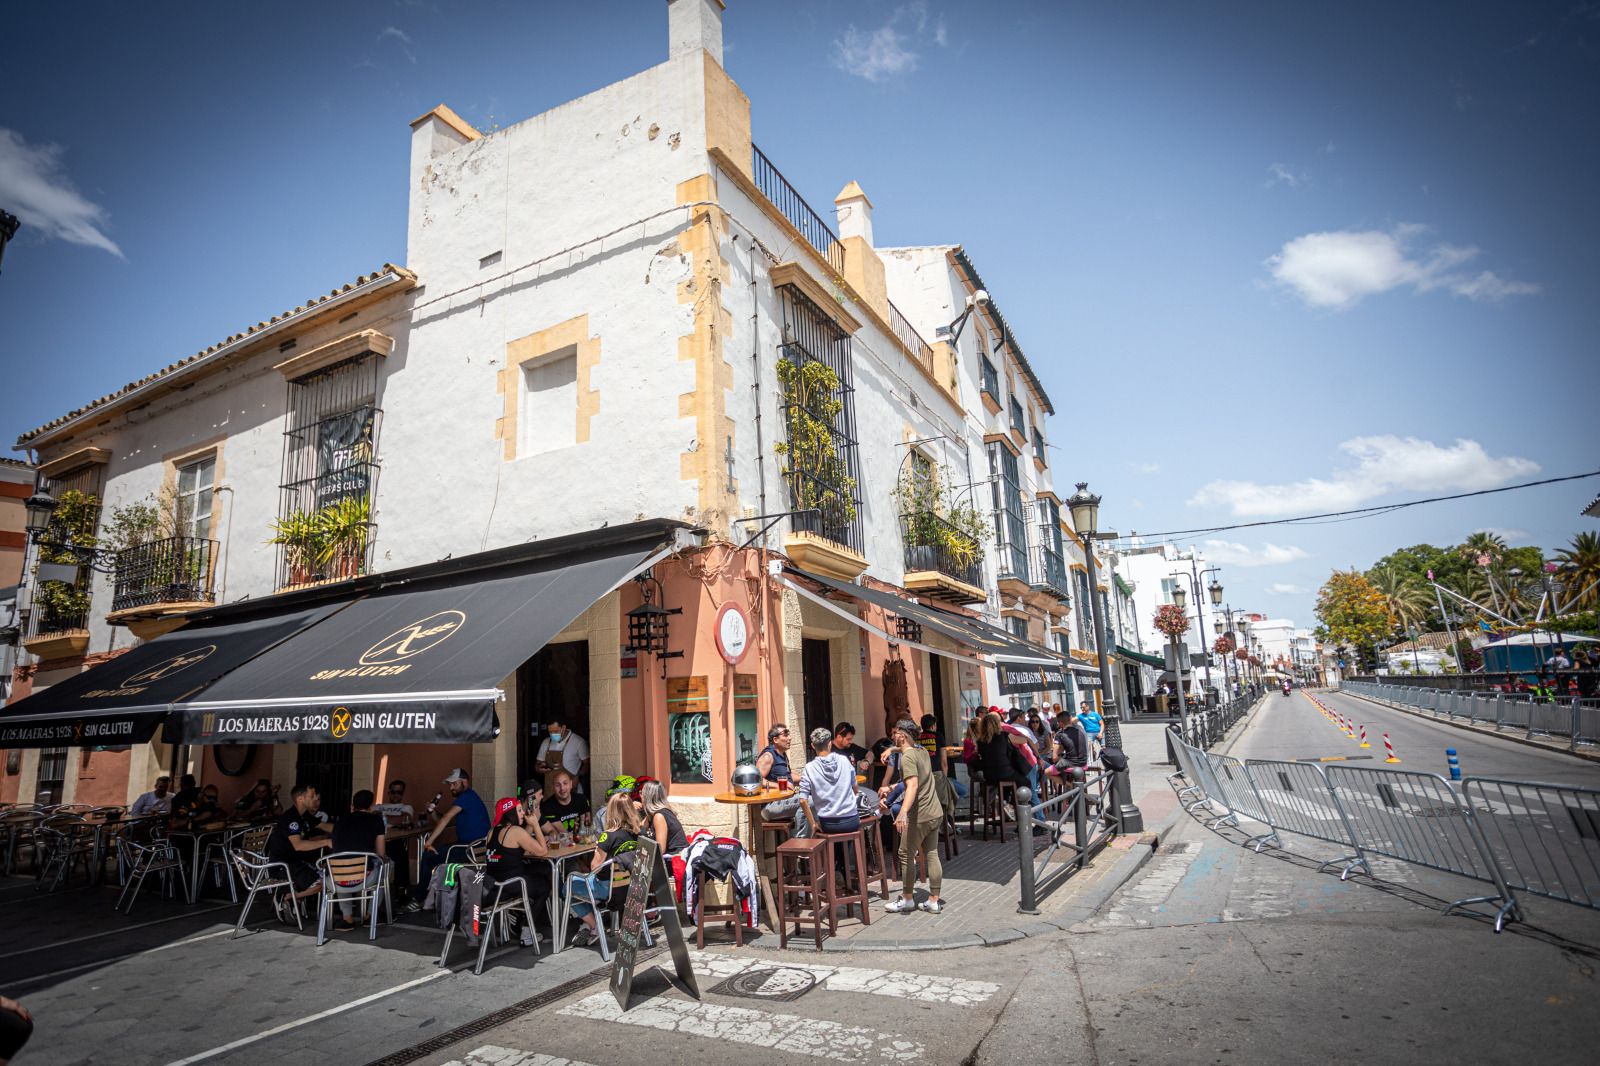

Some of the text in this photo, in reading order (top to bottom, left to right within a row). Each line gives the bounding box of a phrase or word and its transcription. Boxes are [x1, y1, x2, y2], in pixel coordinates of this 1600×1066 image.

[1, 721, 134, 740] LOS MAERAS 1928 SIN GLUTEN
[218, 712, 436, 733] LOS MAERAS 1928 SIN GLUTEN
[502, 801, 514, 811] 93
